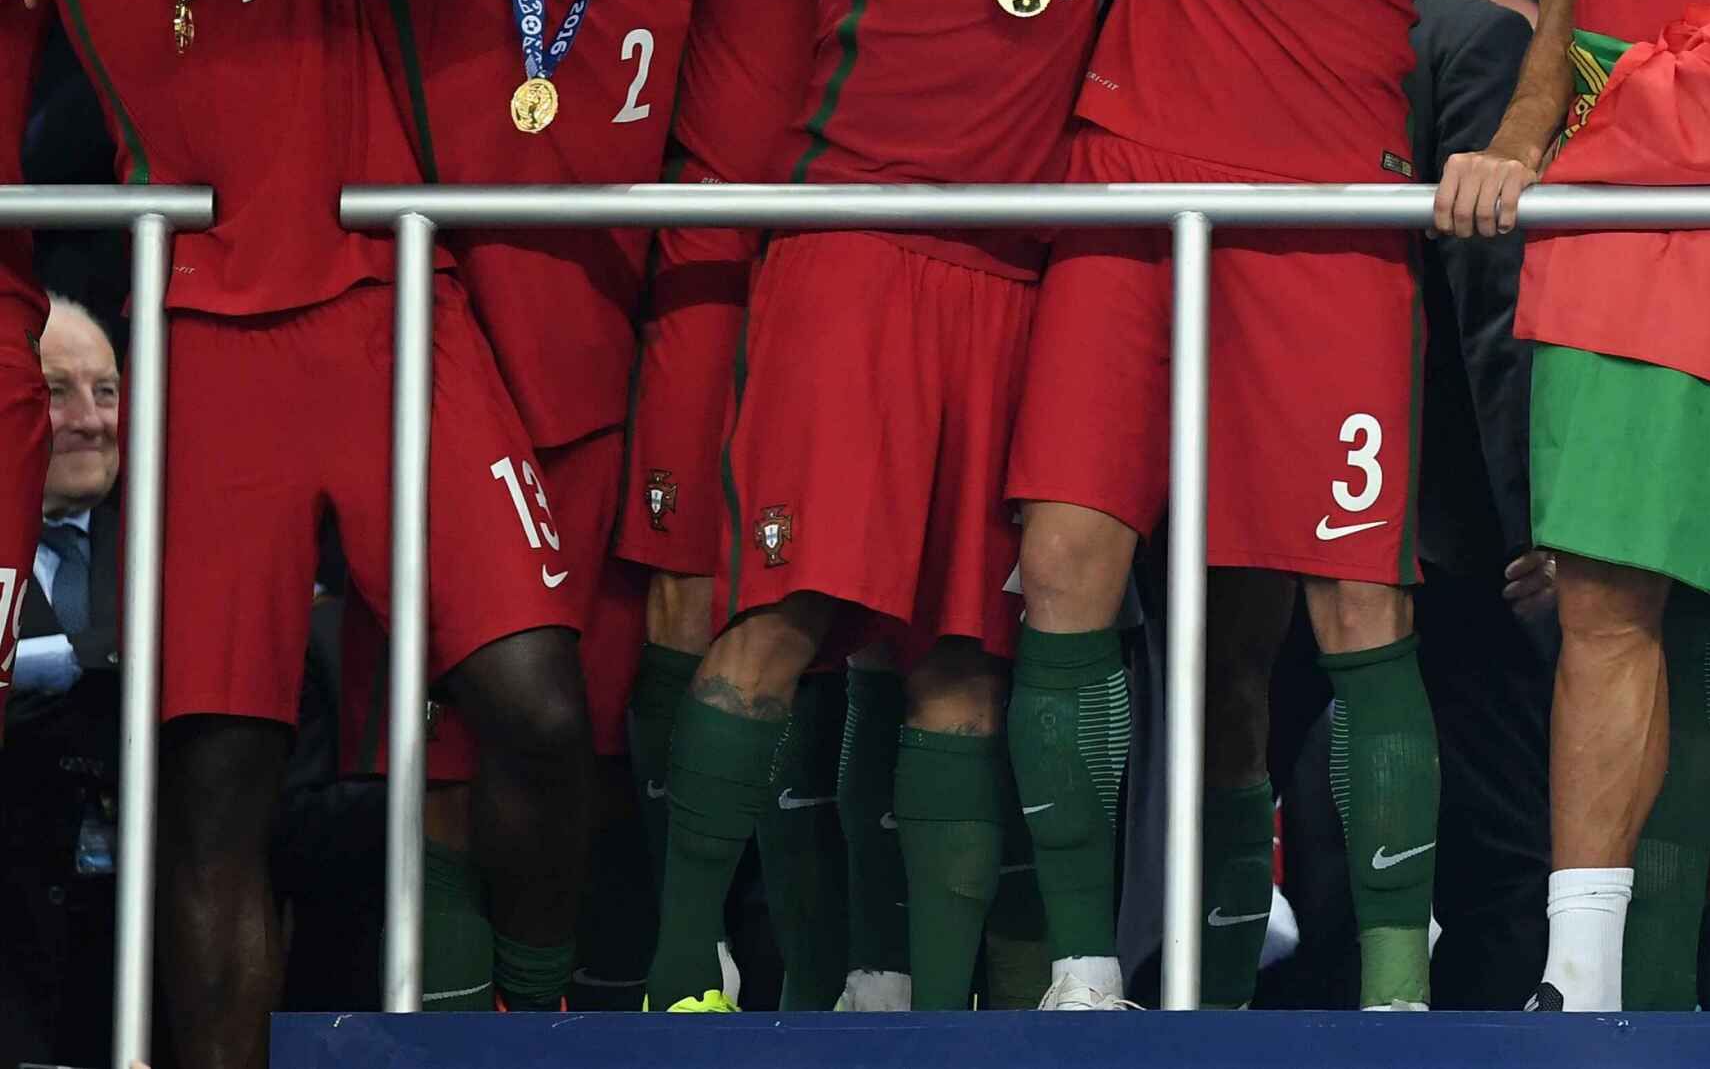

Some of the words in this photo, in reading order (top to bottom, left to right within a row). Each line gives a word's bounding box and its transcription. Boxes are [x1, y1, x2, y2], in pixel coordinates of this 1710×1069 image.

[610, 28, 655, 124] 2
[490, 456, 563, 552] 13
[1331, 412, 1384, 512] 3
